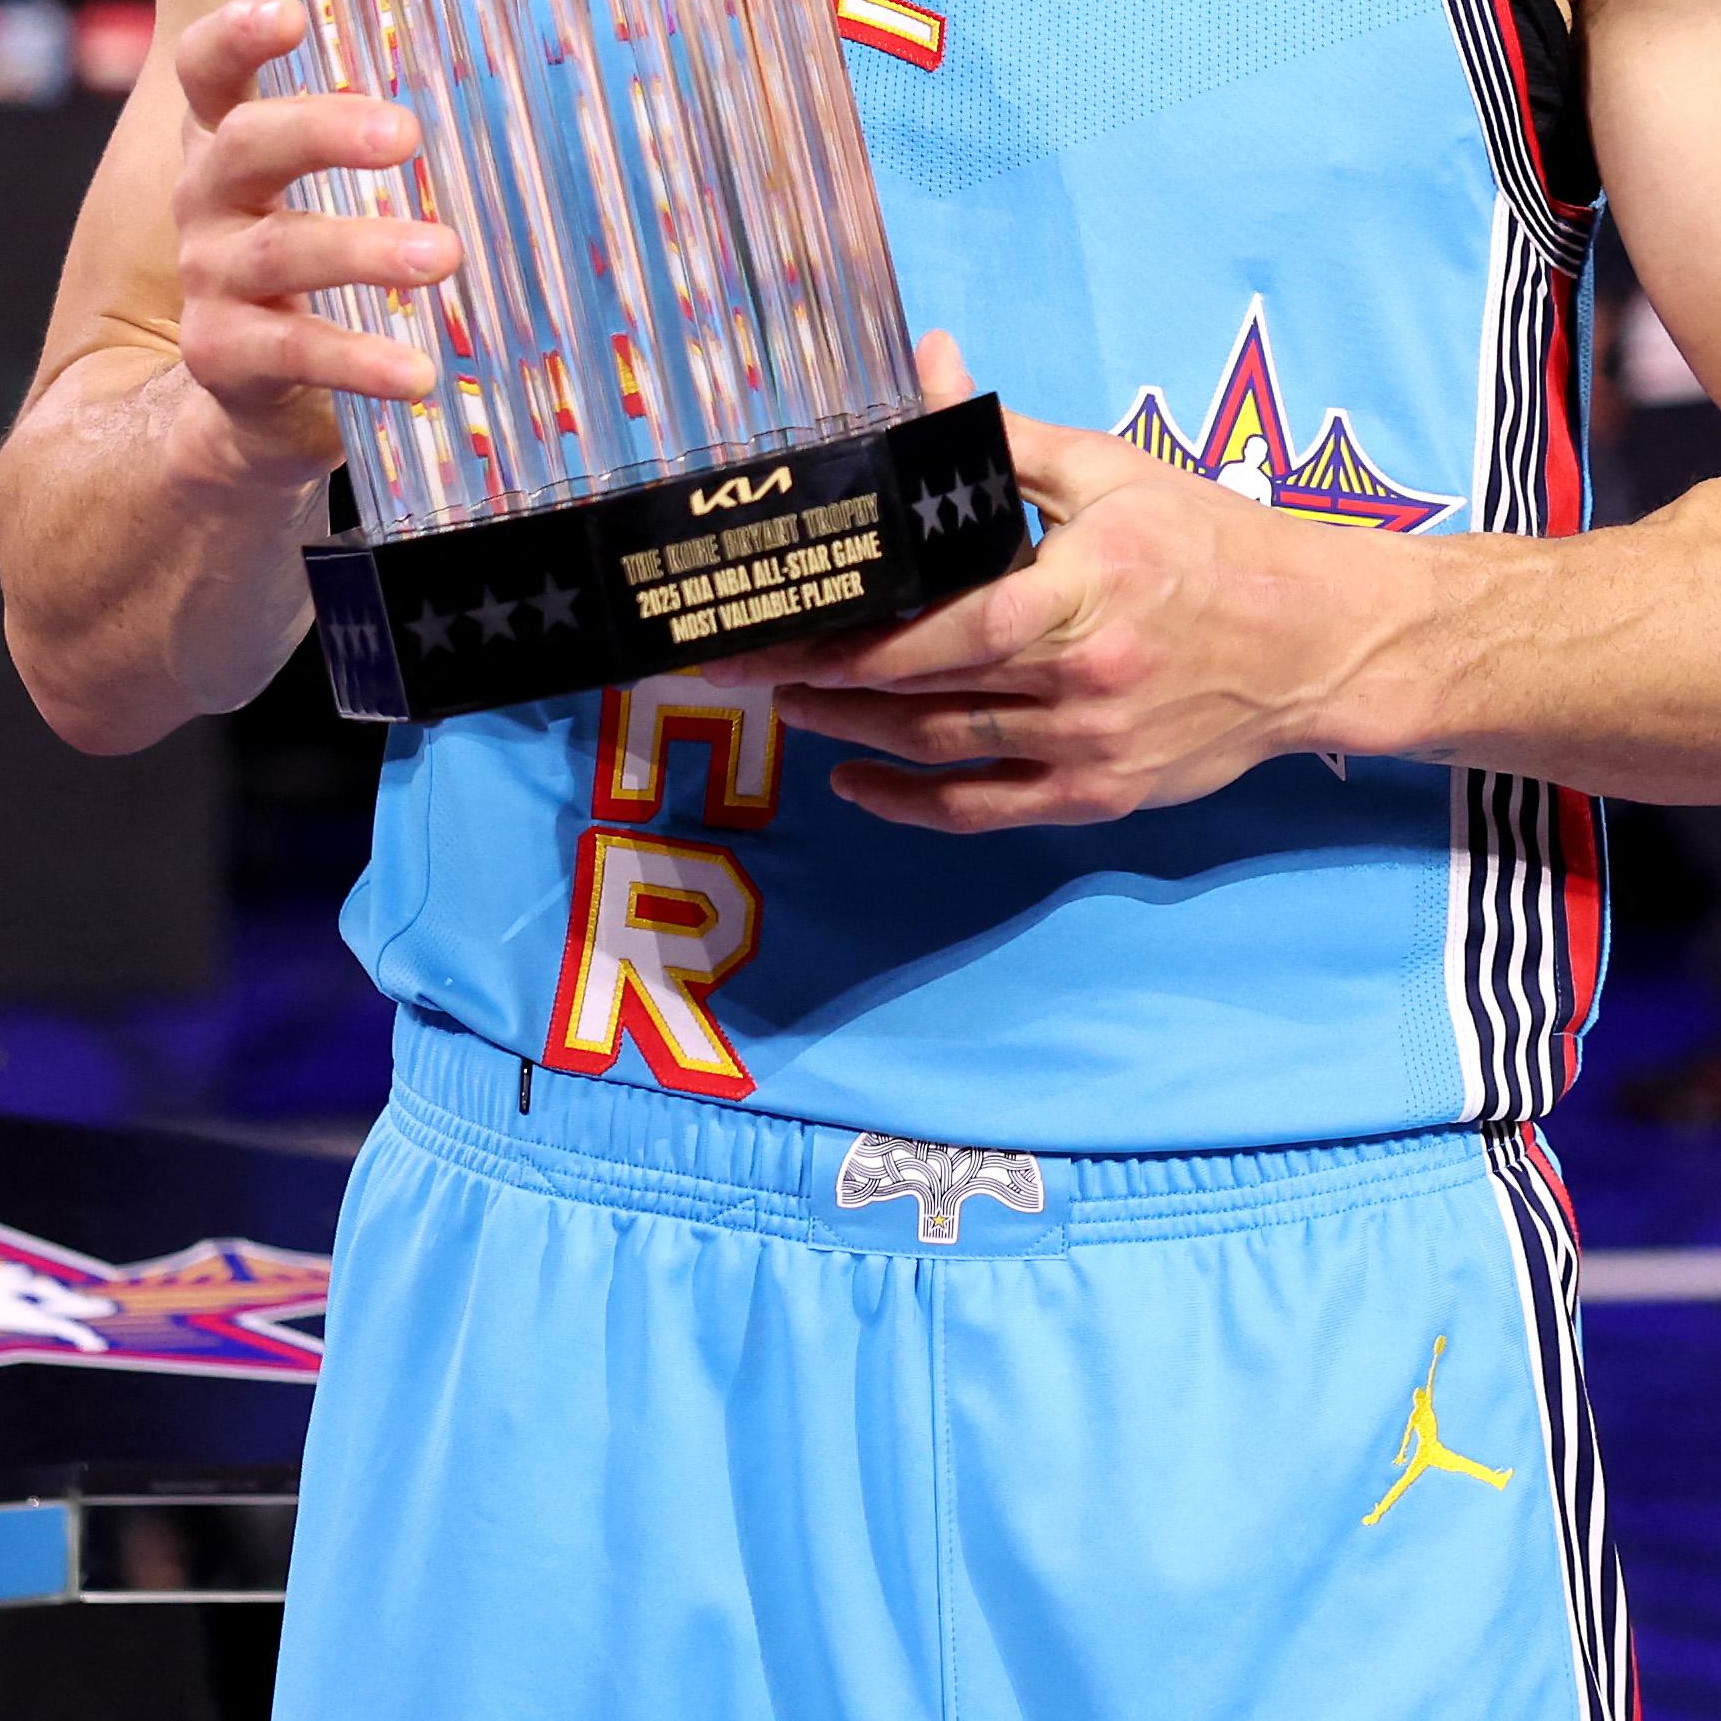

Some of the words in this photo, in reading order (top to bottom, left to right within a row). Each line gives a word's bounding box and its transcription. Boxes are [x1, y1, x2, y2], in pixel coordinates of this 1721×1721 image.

[689, 466, 793, 516] KIA
[620, 548, 664, 586] THE
[663, 534, 721, 575] KOBE
[720, 513, 800, 559] BRYANT
[801, 492, 879, 538] TROPHY
[636, 583, 681, 619] 2025
[680, 575, 715, 607] KIA
[713, 565, 752, 599] NBA
[751, 544, 831, 589] ALL-STAR
[831, 531, 882, 567] GAME
[669, 607, 718, 644] MOST
[716, 586, 802, 630] VALUABLE
[800, 571, 864, 610] PLAYER
